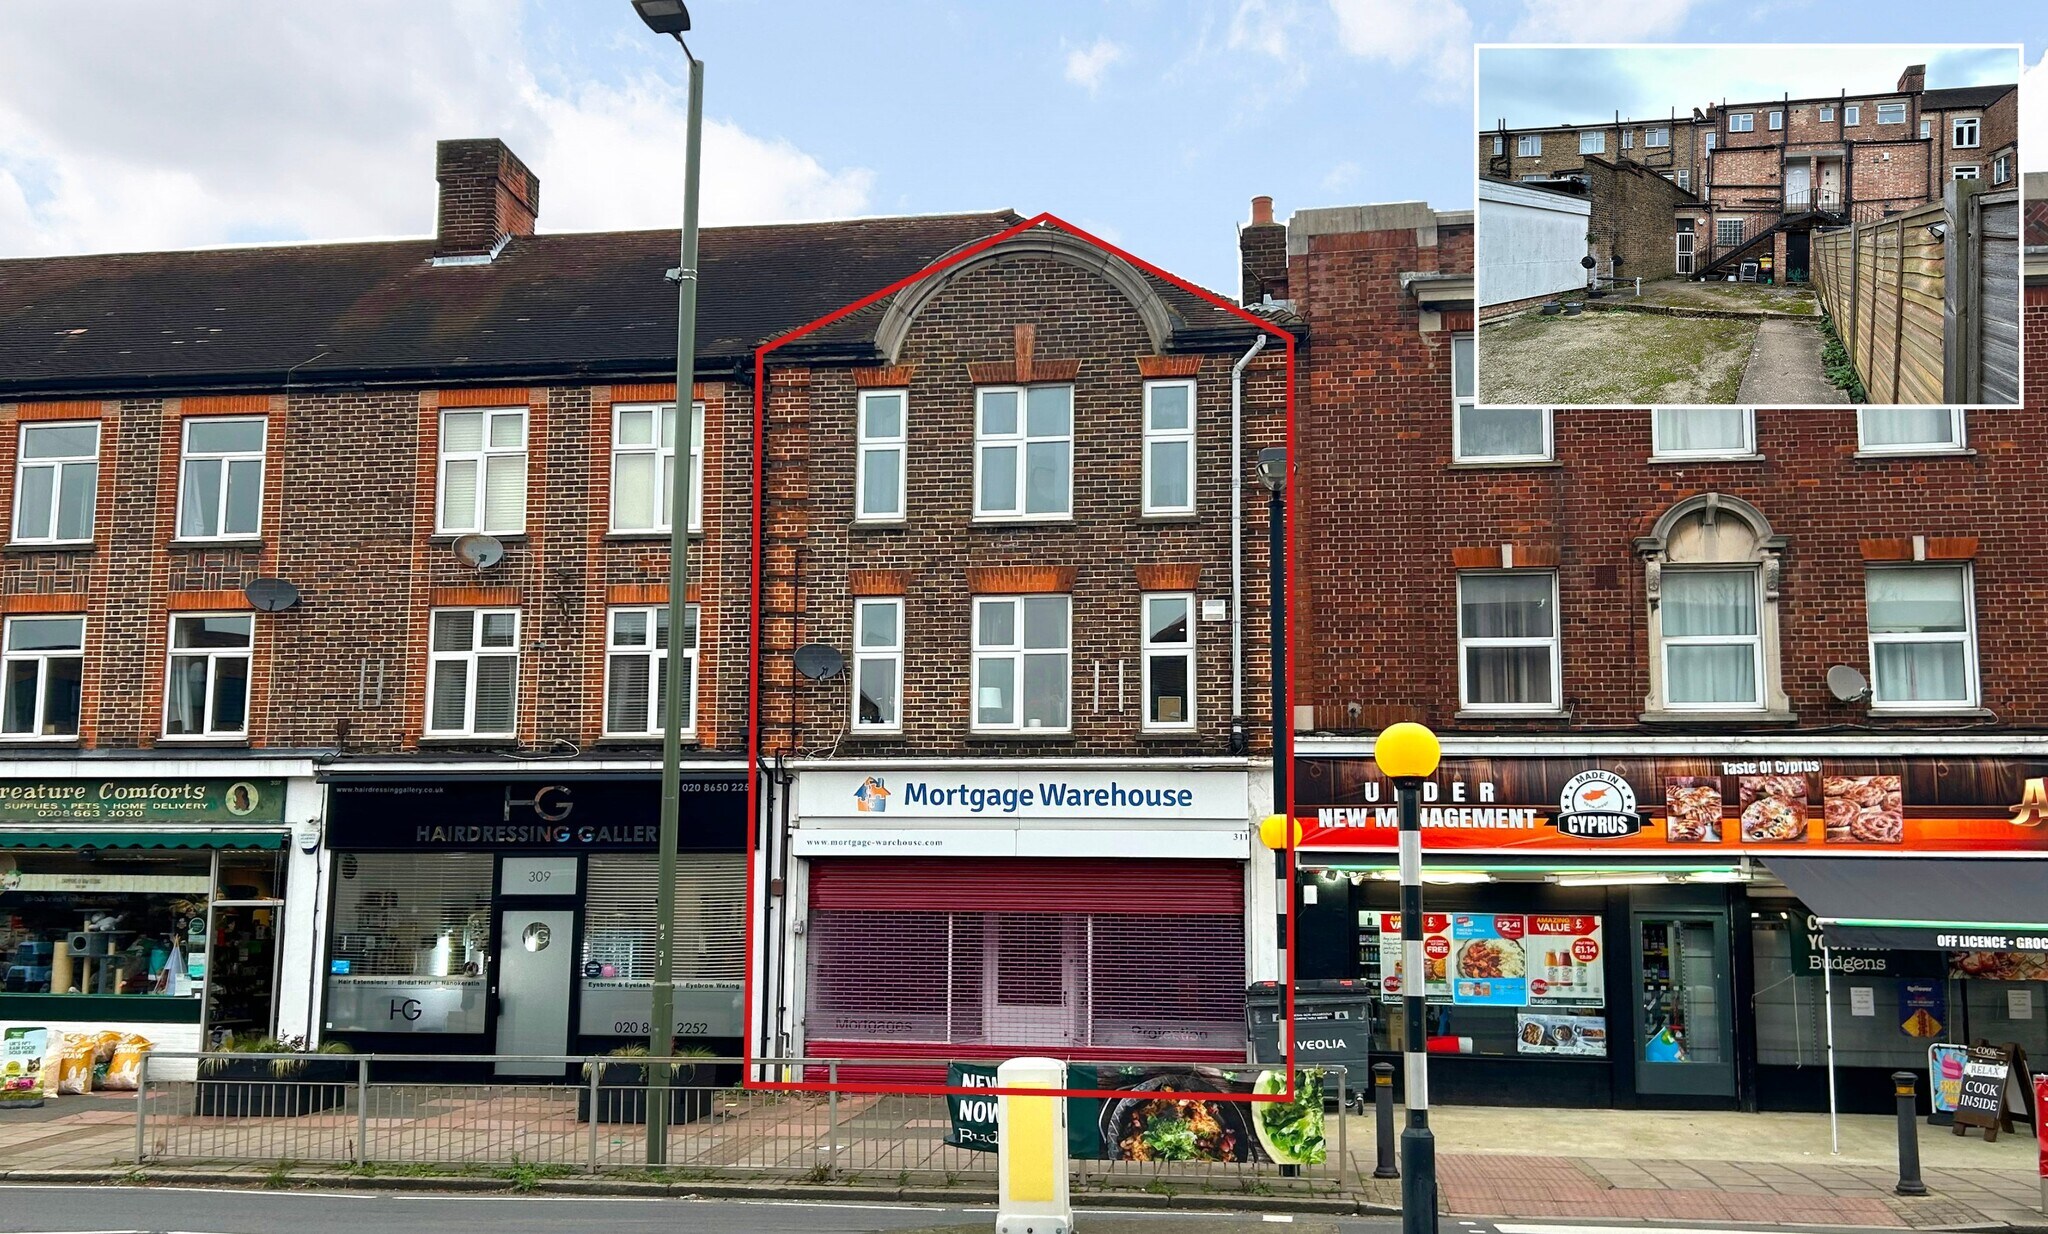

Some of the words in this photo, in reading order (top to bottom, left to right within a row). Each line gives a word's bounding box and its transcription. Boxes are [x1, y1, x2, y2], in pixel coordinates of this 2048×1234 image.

[1722, 761, 1757, 775] Taste
[1760, 761, 1772, 774] Of
[1775, 760, 1820, 774] Cyprus
[1575, 771, 1605, 784] MADE
[1607, 774, 1619, 784] IN
[99, 782, 206, 800] Comforts
[336, 786, 444, 794] www.hairdressinggallery.co.uk
[682, 783, 701, 792] 020
[703, 783, 729, 792] 8650
[731, 783, 749, 792] 225
[1364, 781, 1495, 802] UDER
[503, 785, 574, 821] HG
[904, 782, 1034, 813] Mortgage
[1039, 782, 1193, 806] Warehouse
[1318, 808, 1367, 827] NEW
[1375, 808, 1537, 828] MNAGEMENT
[1567, 815, 1628, 834] CYPRUS
[416, 826, 570, 842] HAIRDRESSING
[577, 825, 660, 842] GALLER
[1233, 833, 1248, 841] 311
[806, 839, 943, 847] www.mortgage-warehouse.com
[528, 871, 551, 882] 309
[1497, 921, 1521, 931] £2.41
[1537, 923, 1571, 932] VALUE
[1937, 935, 1957, 947] OFF
[1960, 935, 2007, 948] LICENCE
[1426, 946, 1448, 954] FREE
[1575, 946, 1597, 954] £1.14
[1808, 955, 1886, 973] Budgens
[389, 999, 422, 1020] HG
[614, 1022, 638, 1033] 020
[677, 1022, 708, 1034] 2252
[1297, 1039, 1347, 1050] VEOLIA
[1975, 1046, 1998, 1056] COOK
[1971, 1064, 2000, 1076] RELAX
[1965, 1081, 1998, 1097] COOK
[1960, 1094, 1998, 1111] INSIDE
[959, 1099, 999, 1124] NOW
[958, 1128, 999, 1144] Bud
